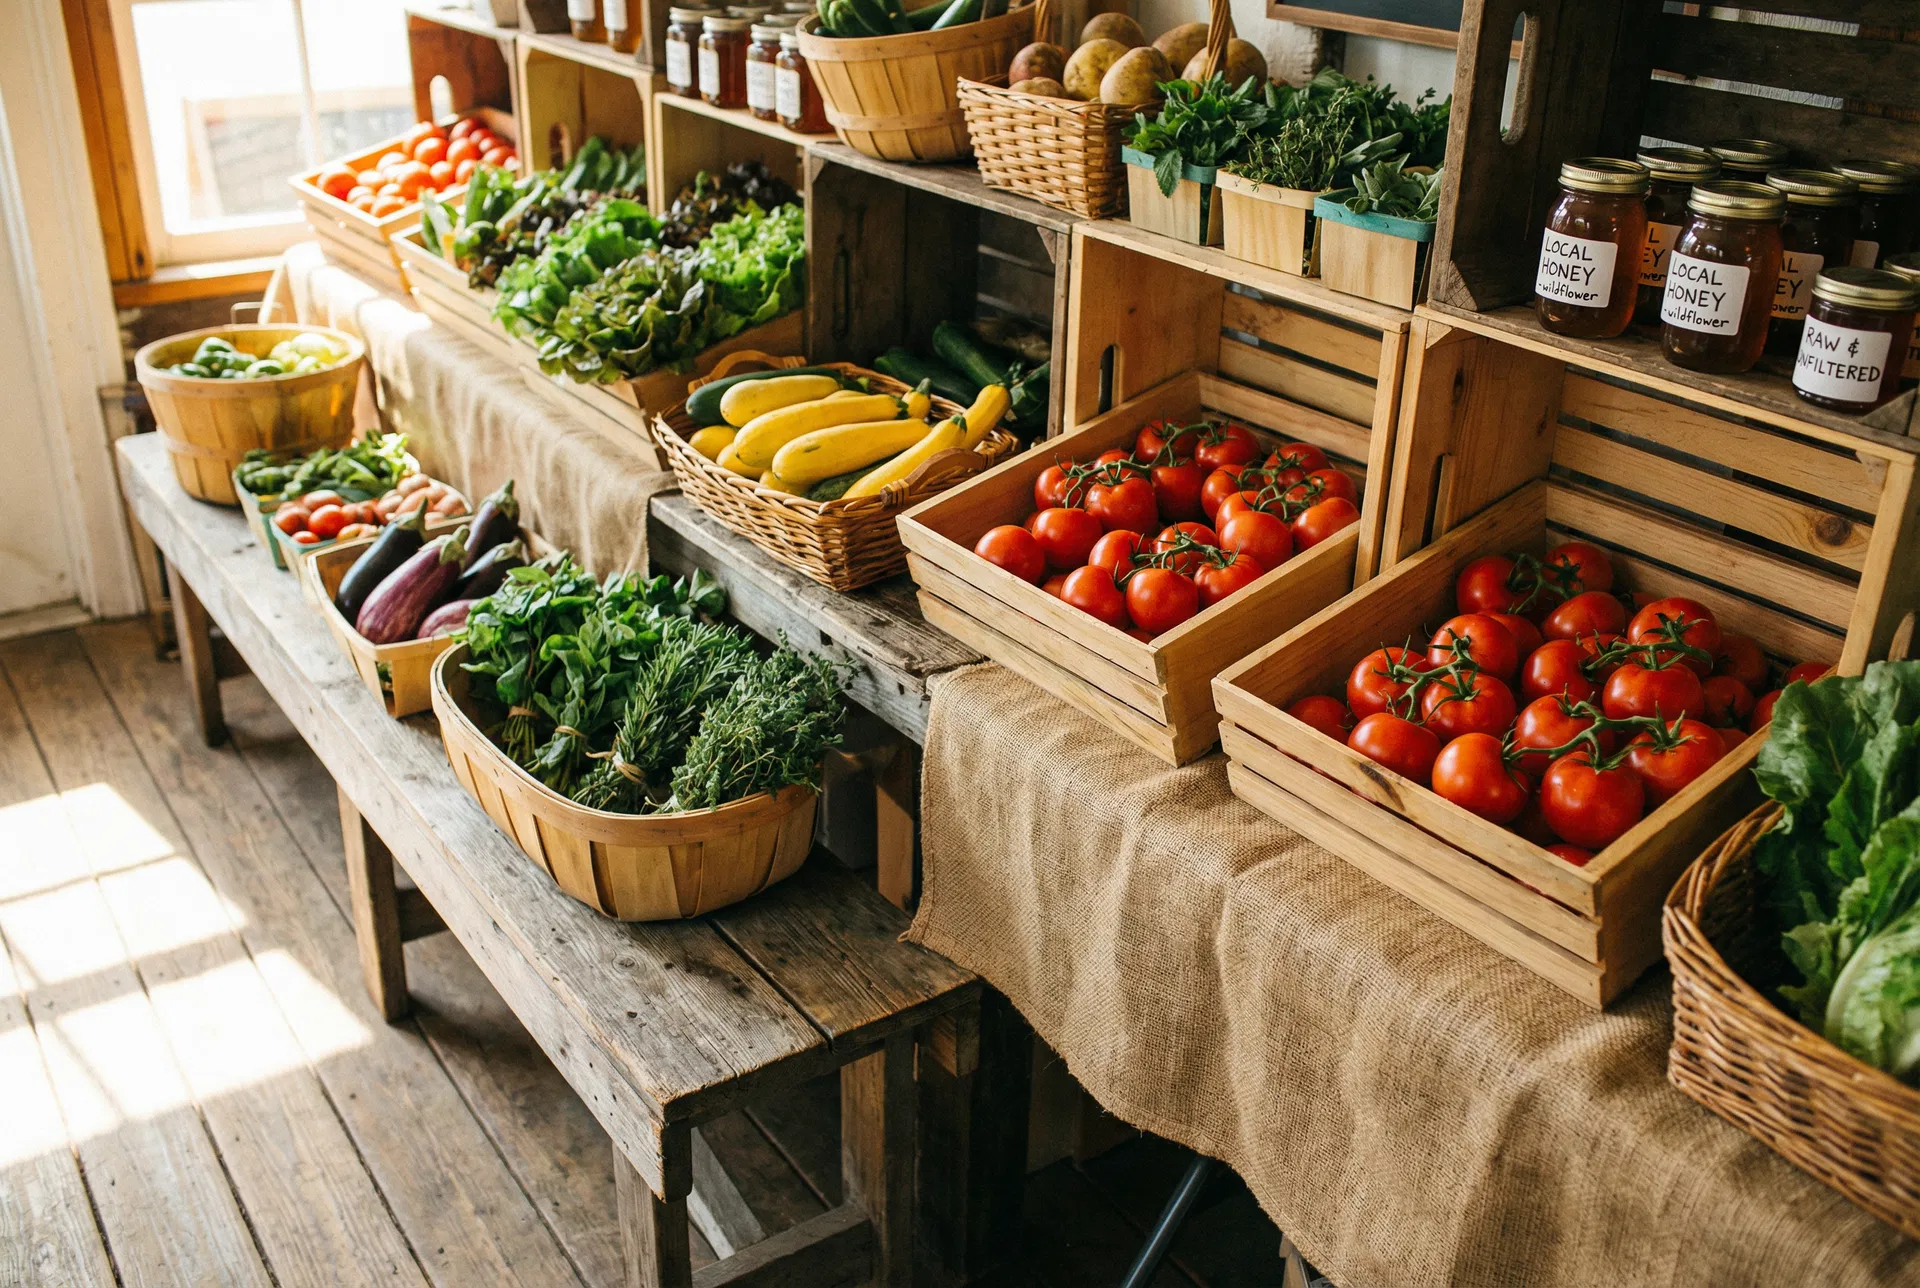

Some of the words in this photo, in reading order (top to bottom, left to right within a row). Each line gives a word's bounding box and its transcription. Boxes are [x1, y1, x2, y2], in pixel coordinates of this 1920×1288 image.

[1545, 236, 1593, 261] LOCAL
[1542, 256, 1596, 286] HONEY
[1672, 257, 1723, 286] LOCAL
[1667, 280, 1726, 312] HONEY
[1806, 326, 1841, 352] RAW
[1847, 337, 1860, 358] &
[1797, 349, 1881, 382] NFILTERED
